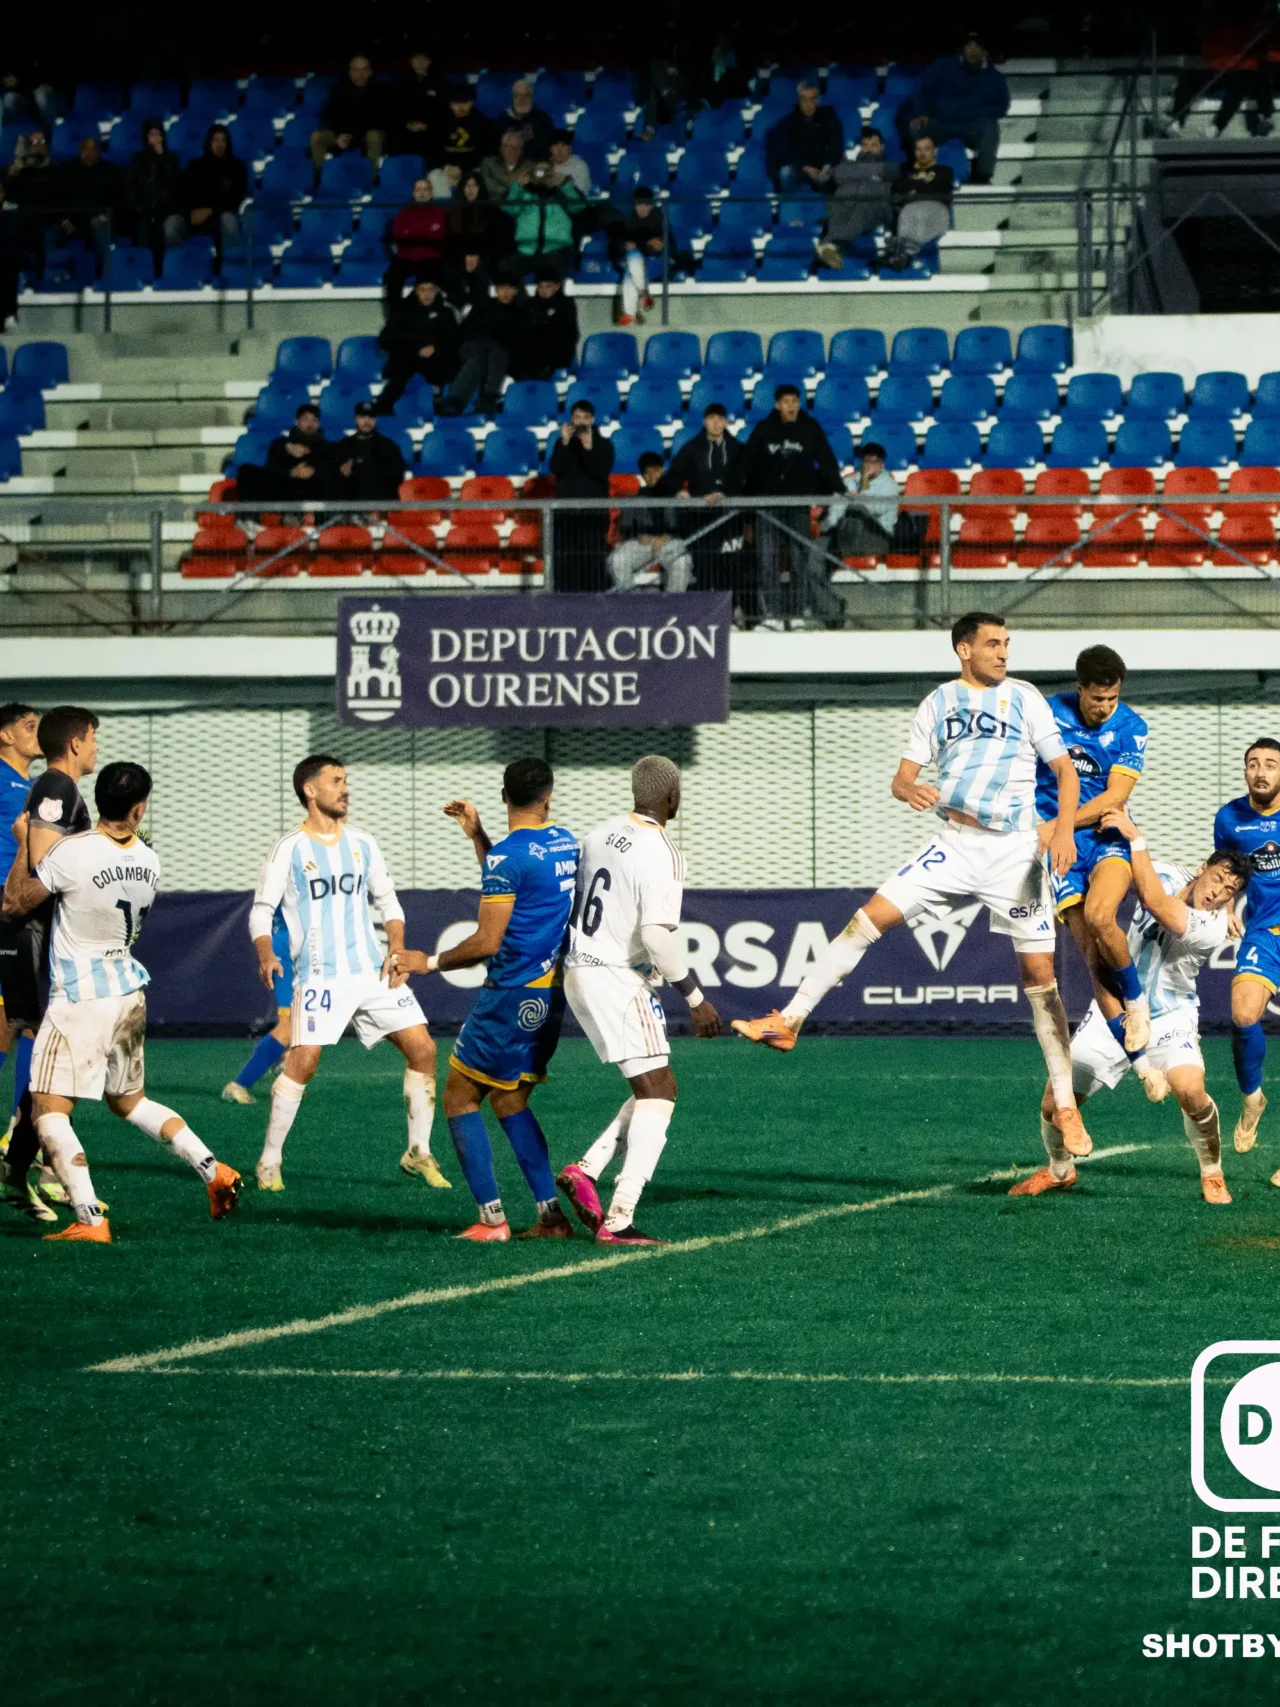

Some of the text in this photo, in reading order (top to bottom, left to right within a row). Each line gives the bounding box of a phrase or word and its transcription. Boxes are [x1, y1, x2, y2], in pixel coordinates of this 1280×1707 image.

[430, 617, 719, 663] DEPUTACIÓN
[428, 672, 641, 708] OURENSE
[946, 712, 1010, 740] DIGI
[1071, 757, 1093, 773] rella
[916, 844, 946, 872] 12
[309, 872, 363, 901] DIGI
[582, 867, 612, 937] 6
[1008, 904, 1048, 919] esfer
[1246, 946, 1258, 964] 4
[305, 989, 331, 1013] 24
[863, 985, 1018, 1005] CUPRA
